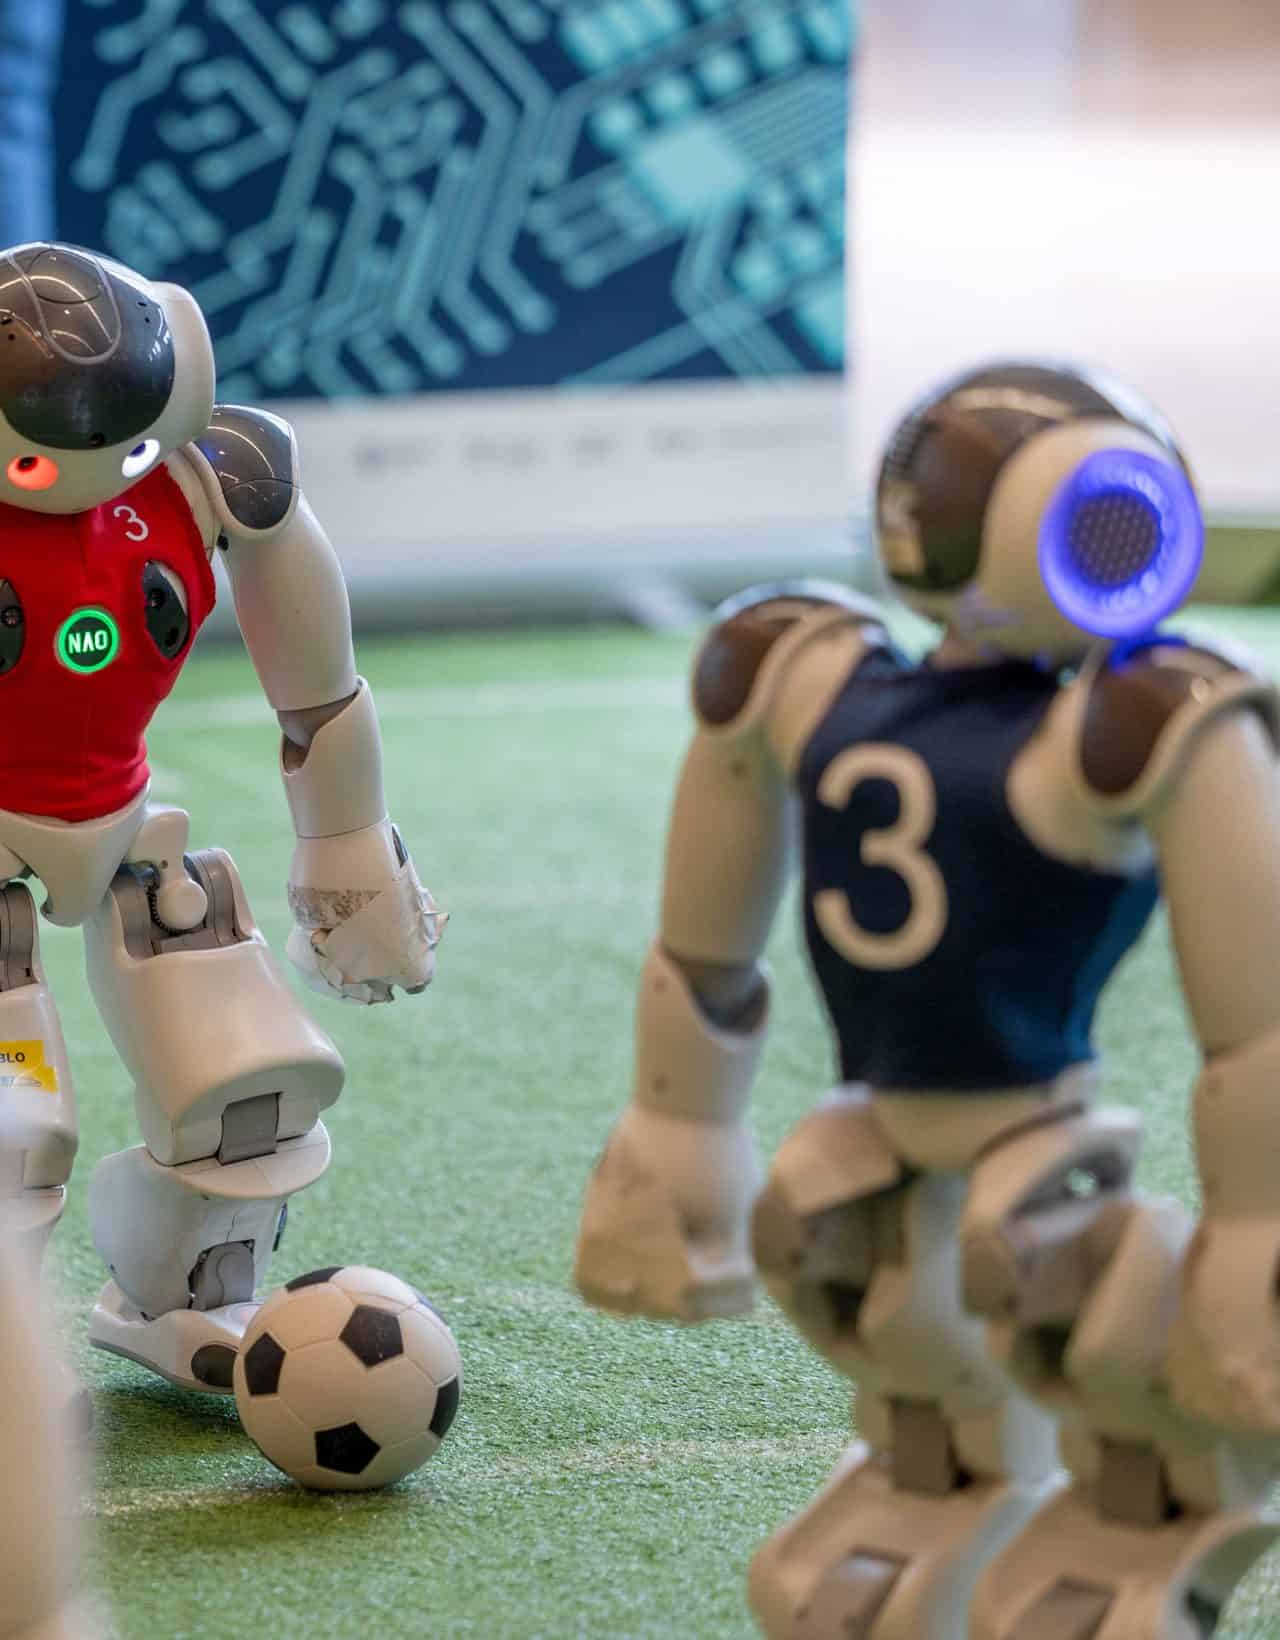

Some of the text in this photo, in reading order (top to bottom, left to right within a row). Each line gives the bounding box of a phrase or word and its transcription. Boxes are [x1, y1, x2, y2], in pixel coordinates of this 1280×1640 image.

[113, 505, 149, 541] 3
[68, 629, 109, 654] NAO
[813, 742, 948, 970] 3
